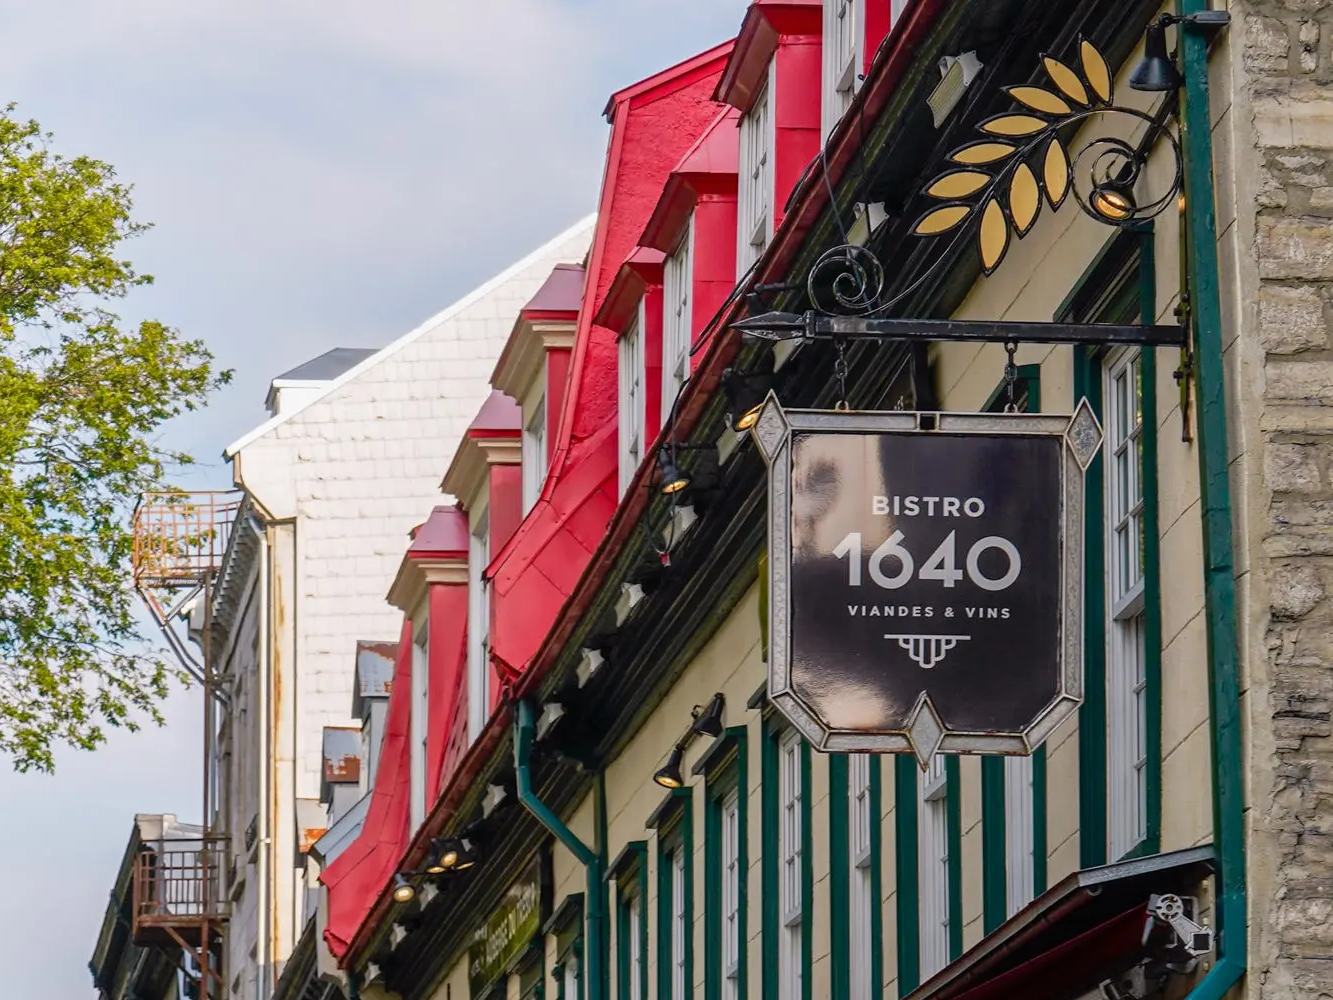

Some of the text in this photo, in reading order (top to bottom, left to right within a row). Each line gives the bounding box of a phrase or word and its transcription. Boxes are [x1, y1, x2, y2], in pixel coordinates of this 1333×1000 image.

[871, 495, 986, 518] BISTRO
[832, 529, 1021, 591] 1640
[848, 605, 1011, 619] VIANDES & VINS
